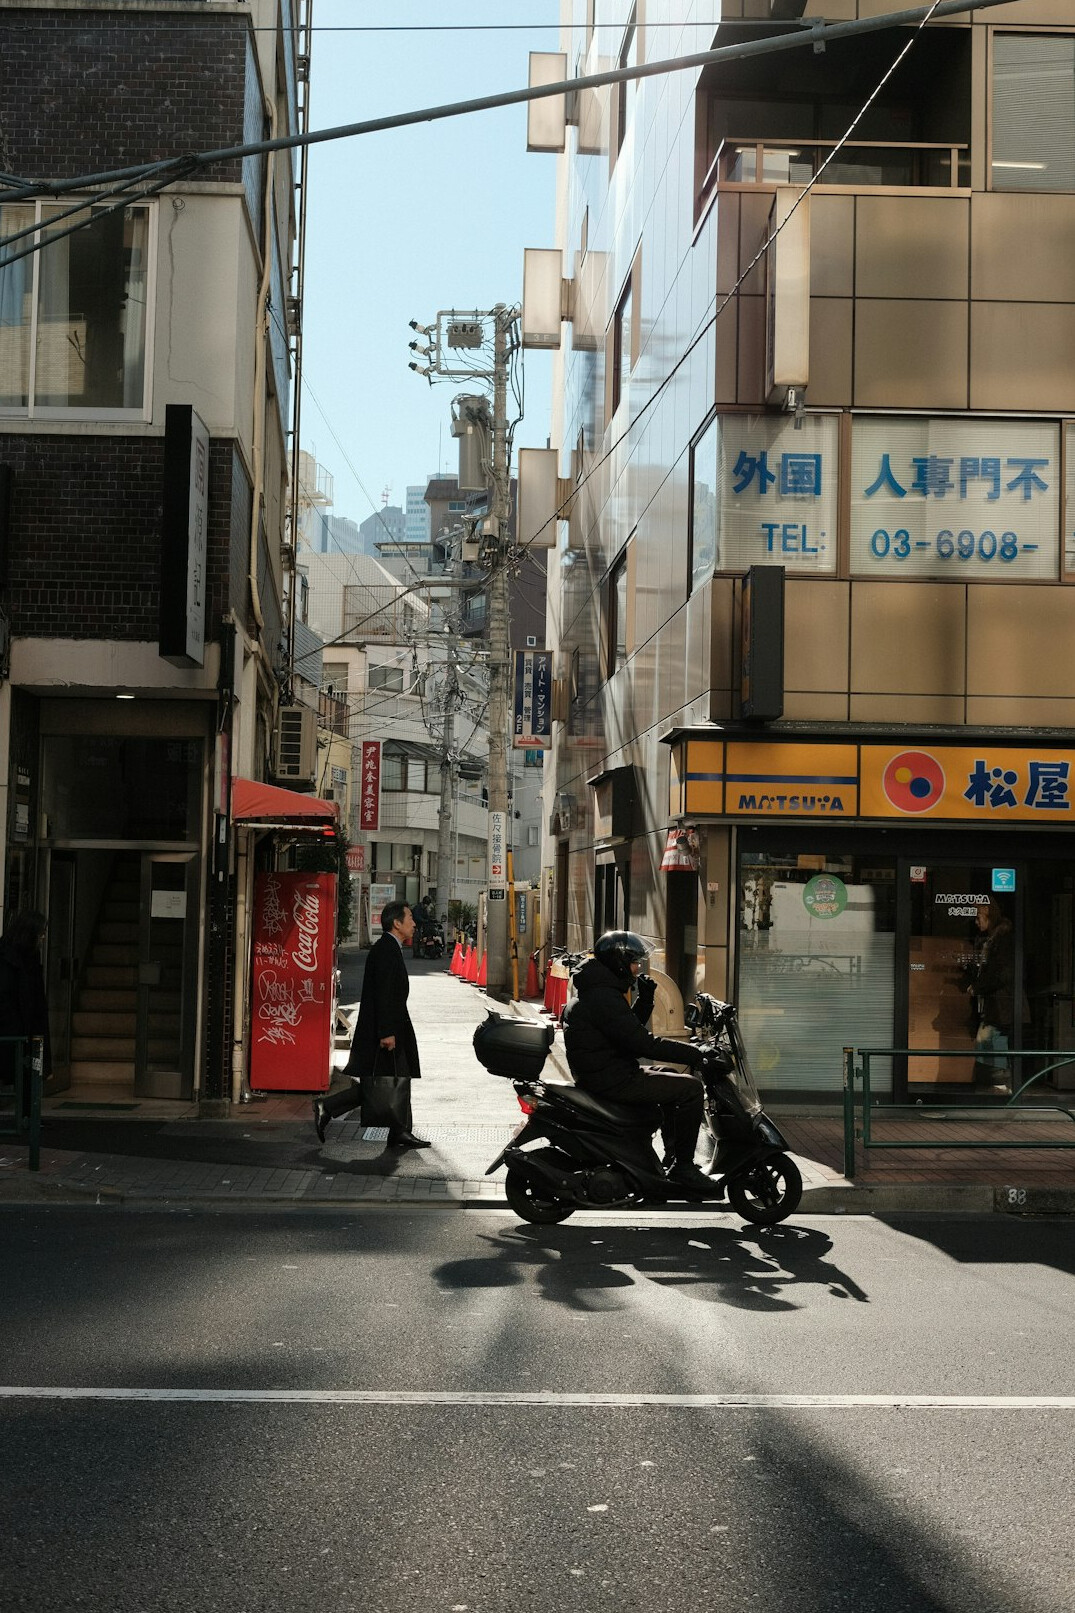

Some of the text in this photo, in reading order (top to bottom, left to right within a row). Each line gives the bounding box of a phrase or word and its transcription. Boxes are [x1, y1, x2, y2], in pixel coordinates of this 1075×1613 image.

[732, 450, 1049, 500] 外国 人専門不
[761, 523, 1039, 560] TEL: 03-6908-
[537, 657, 546, 733] アパート・マンション
[516, 715, 523, 733] 2F
[738, 795, 844, 812] MATSUYA
[963, 760, 1071, 809] 松屋
[492, 813, 502, 864] 佐々接骨院
[935, 894, 990, 904] MATSUYA
